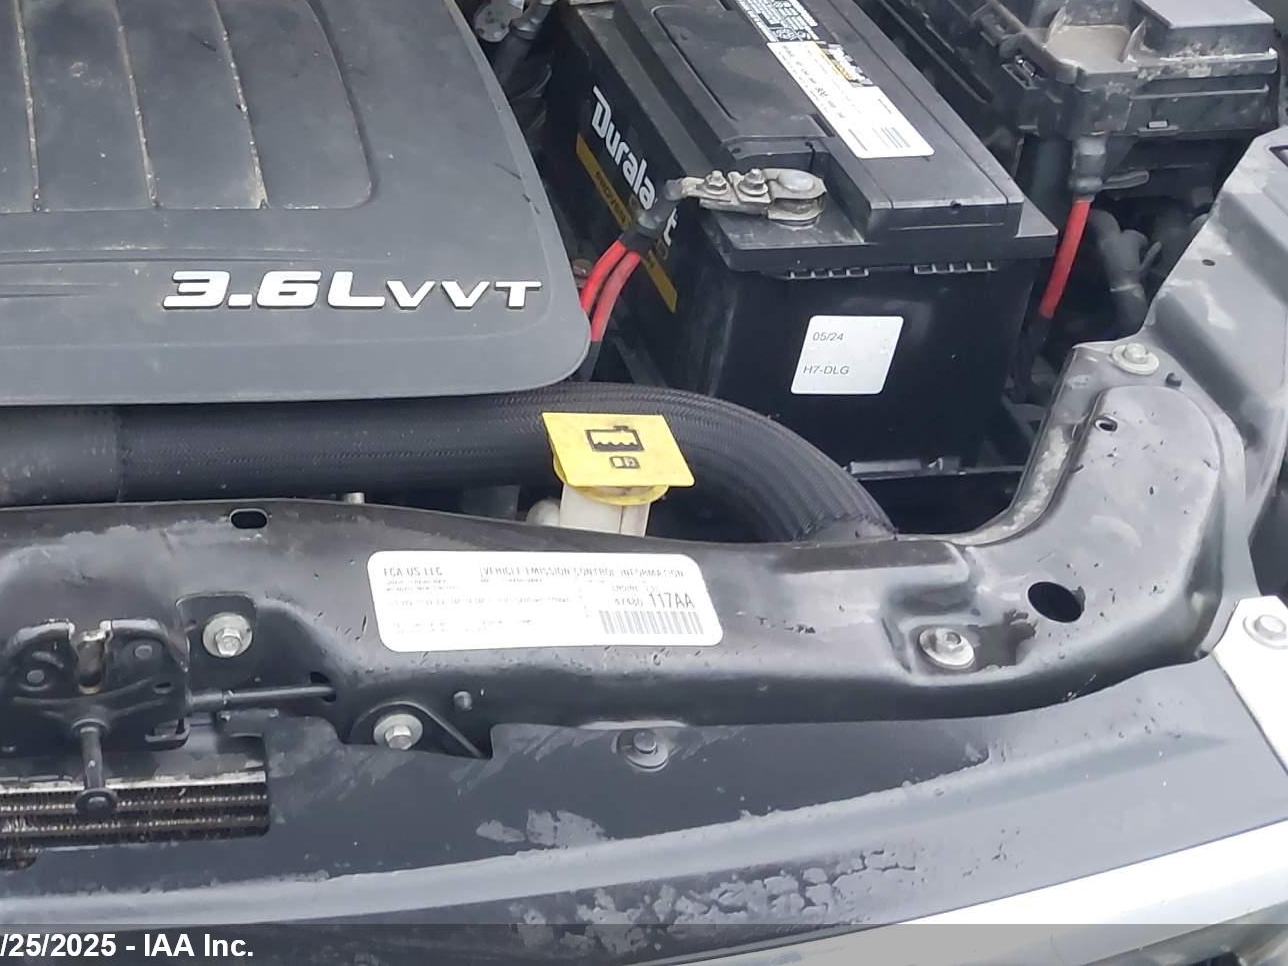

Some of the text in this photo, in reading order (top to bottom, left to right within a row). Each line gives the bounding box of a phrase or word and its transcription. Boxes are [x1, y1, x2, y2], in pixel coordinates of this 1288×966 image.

[591, 85, 679, 247] Duralat
[811, 331, 844, 342] 05/24
[802, 365, 850, 375] H7-DLG
[649, 591, 695, 610] 117AA
